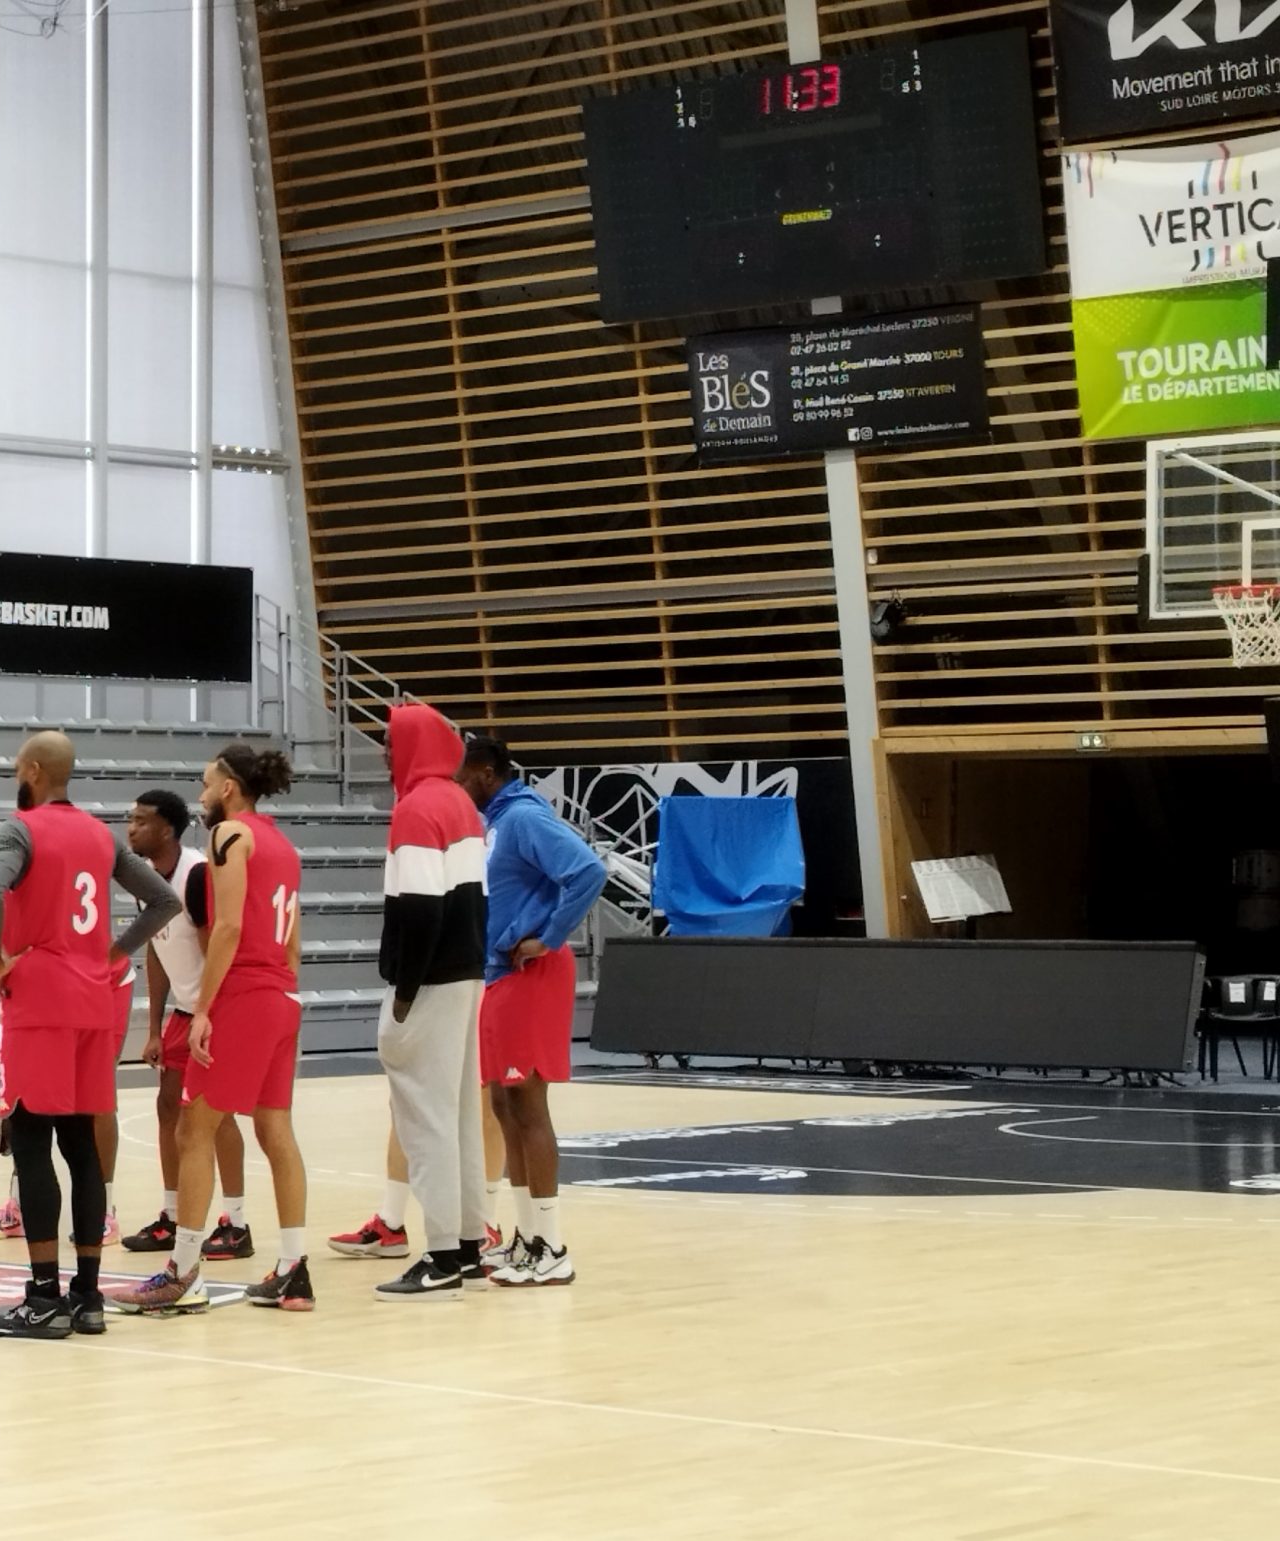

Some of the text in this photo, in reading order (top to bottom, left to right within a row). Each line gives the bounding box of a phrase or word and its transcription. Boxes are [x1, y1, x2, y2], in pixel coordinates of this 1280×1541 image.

[1112, 65, 1213, 99] Movement
[1219, 57, 1259, 82] that
[1160, 99, 1184, 112] SUD
[1186, 92, 1219, 107] LOIRE
[1222, 83, 1271, 101] MOTORS
[1139, 198, 1280, 247] VERTIC
[696, 352, 729, 372] Les
[840, 358, 868, 371] Grand
[903, 352, 933, 364] 37000
[1117, 335, 1268, 381] TOURAIN
[1122, 370, 1280, 404] LE DÉPARTEMEN
[702, 413, 772, 433] de Demain
[72, 871, 98, 935] 3
[272, 884, 298, 947] 11
